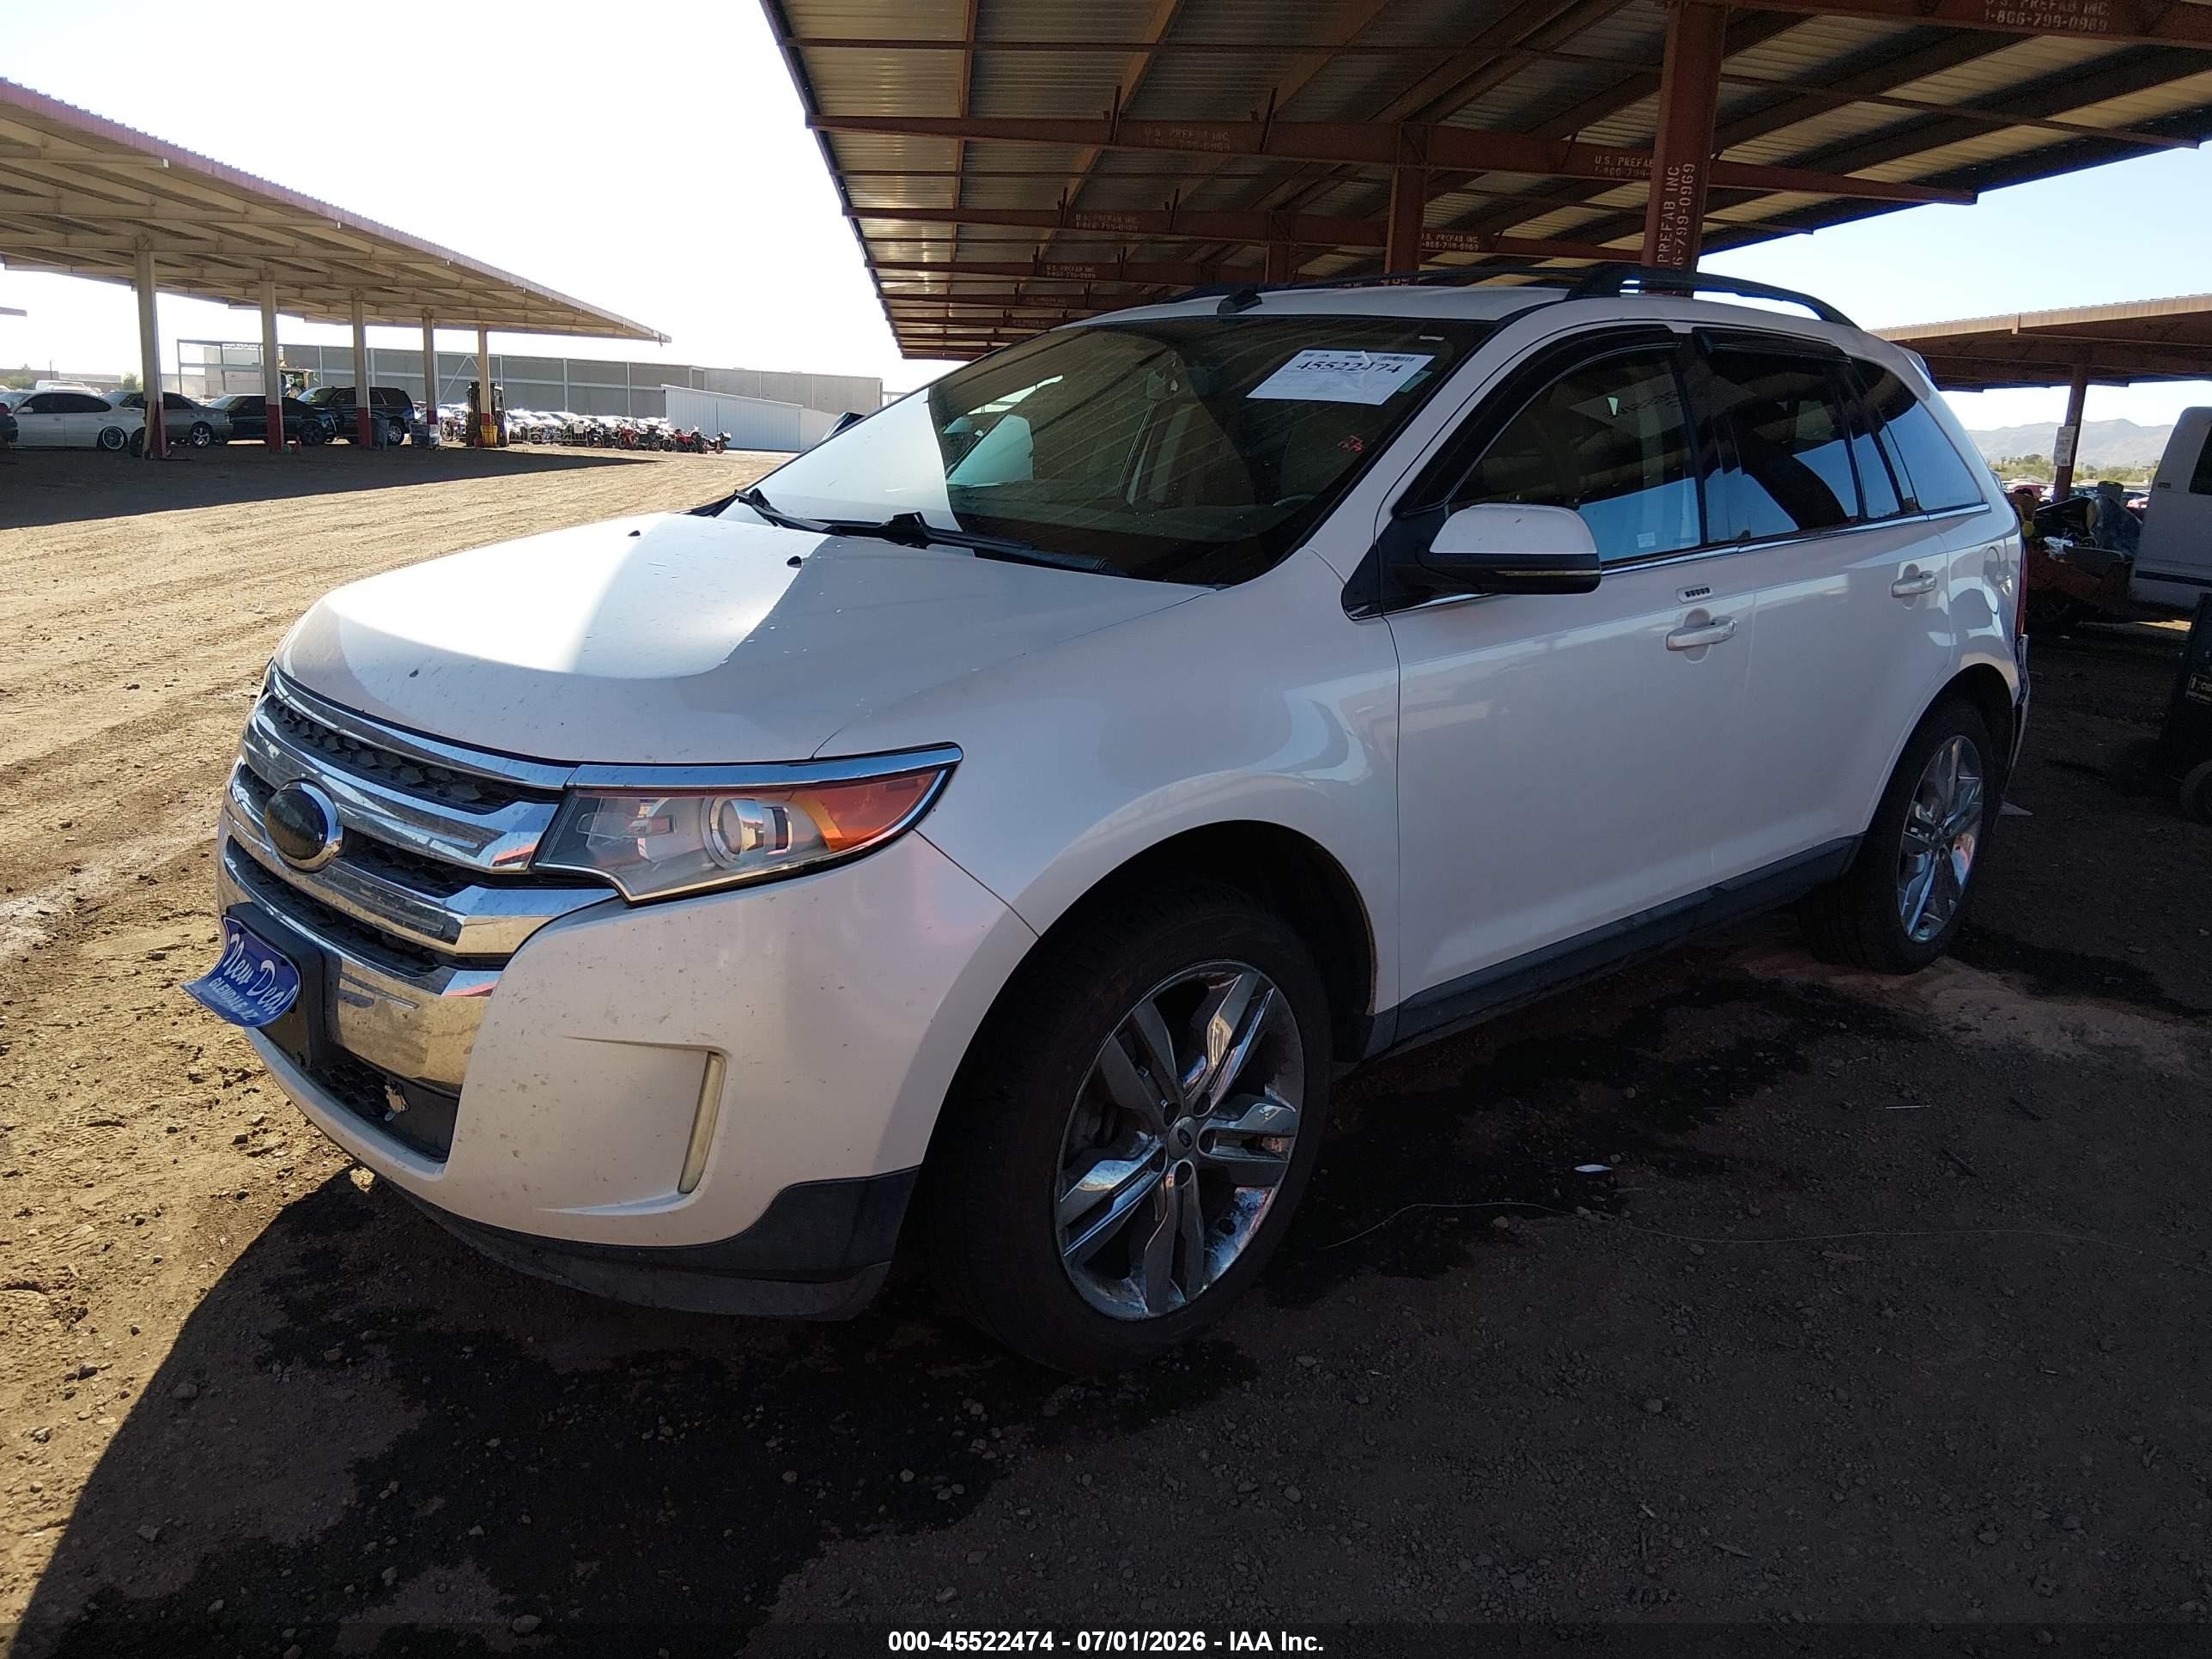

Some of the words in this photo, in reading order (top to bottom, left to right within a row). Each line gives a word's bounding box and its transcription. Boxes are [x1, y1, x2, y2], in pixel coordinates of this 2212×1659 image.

[1656, 201, 1676, 263] PREFAB
[1673, 163, 1696, 270] 6-799-0969
[1297, 360, 1402, 374] 45522474
[222, 933, 255, 986] New
[246, 959, 297, 1015] Deal
